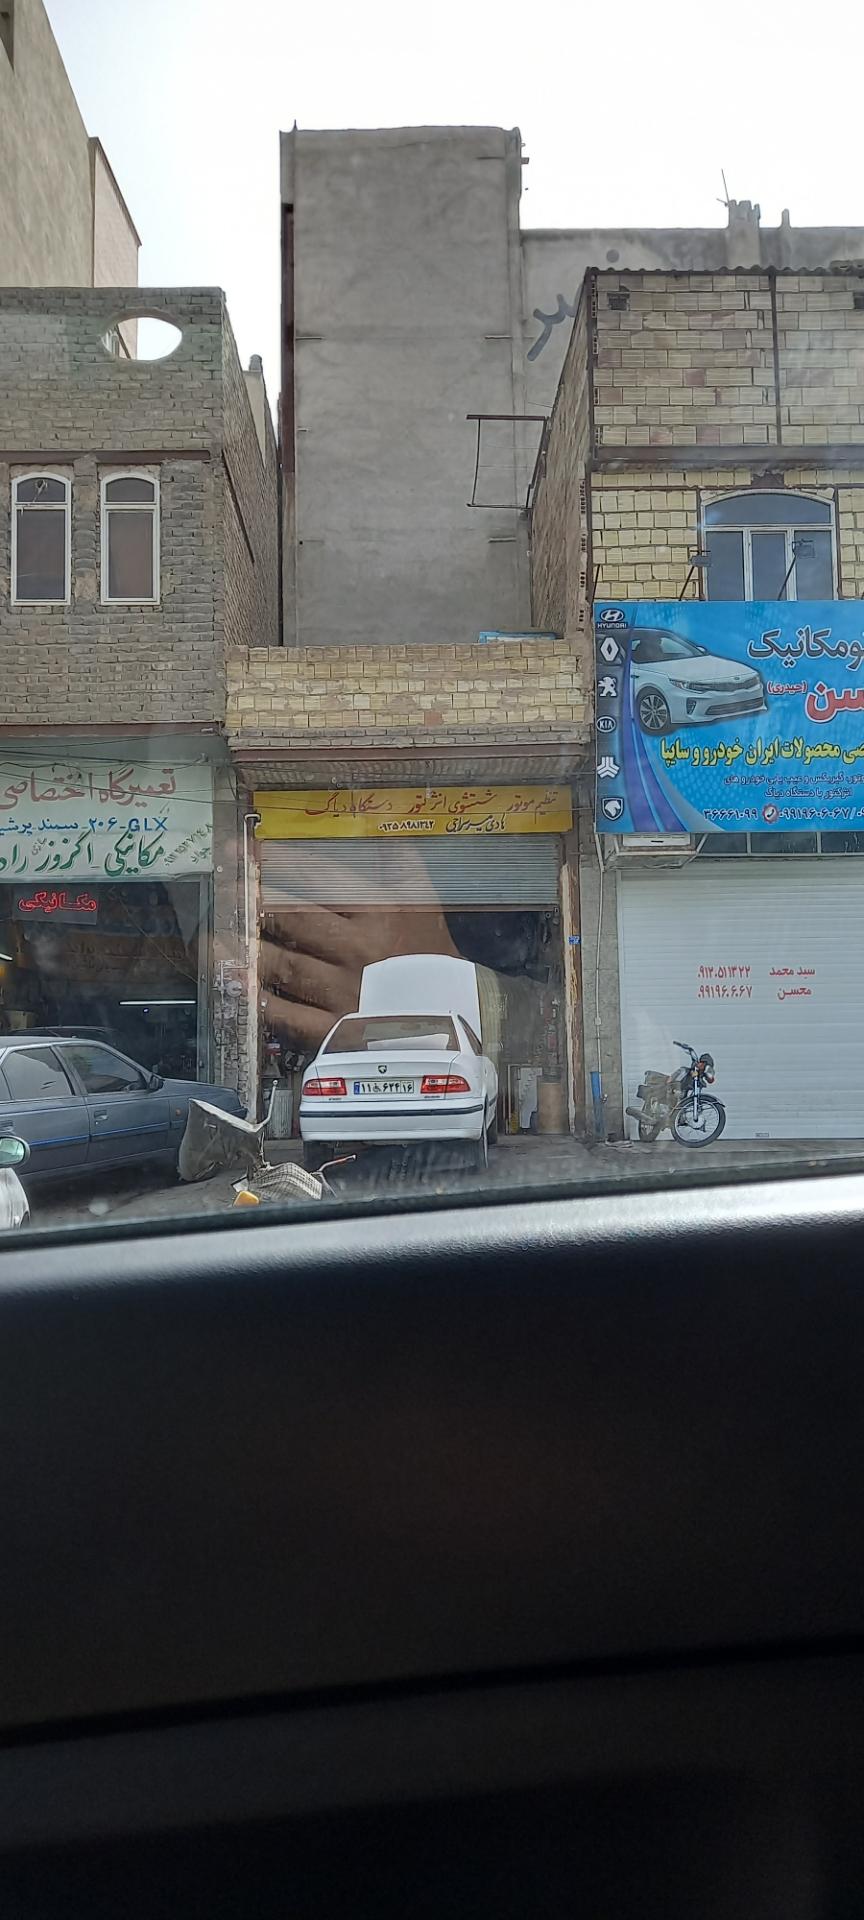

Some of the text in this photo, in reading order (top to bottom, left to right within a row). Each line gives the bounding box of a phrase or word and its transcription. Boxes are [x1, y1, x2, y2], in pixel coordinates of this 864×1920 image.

[597, 622, 627, 630] HYUNDAI
[747, 624, 864, 671] ومکانیک
[660, 738, 690, 768] سایپا
[745, 736, 780, 766] ایران
[780, 736, 841, 766] محصولات
[0, 768, 176, 810] تعمیرگاه اختصاصی
[786, 785, 815, 798] دستگاه
[506, 795, 534, 812] موتور
[703, 807, 758, 820] ۳۶۶۶۱۰۹۹
[38, 818, 79, 831] سمند
[104, 830, 165, 877] مکانیکی
[18, 892, 97, 913] مکانیکی
[769, 966, 794, 976] محمد
[797, 966, 816, 979] سید
[698, 985, 812, 1000] محسن ۰۹۹۱۹۶۰۶۰۶۷
